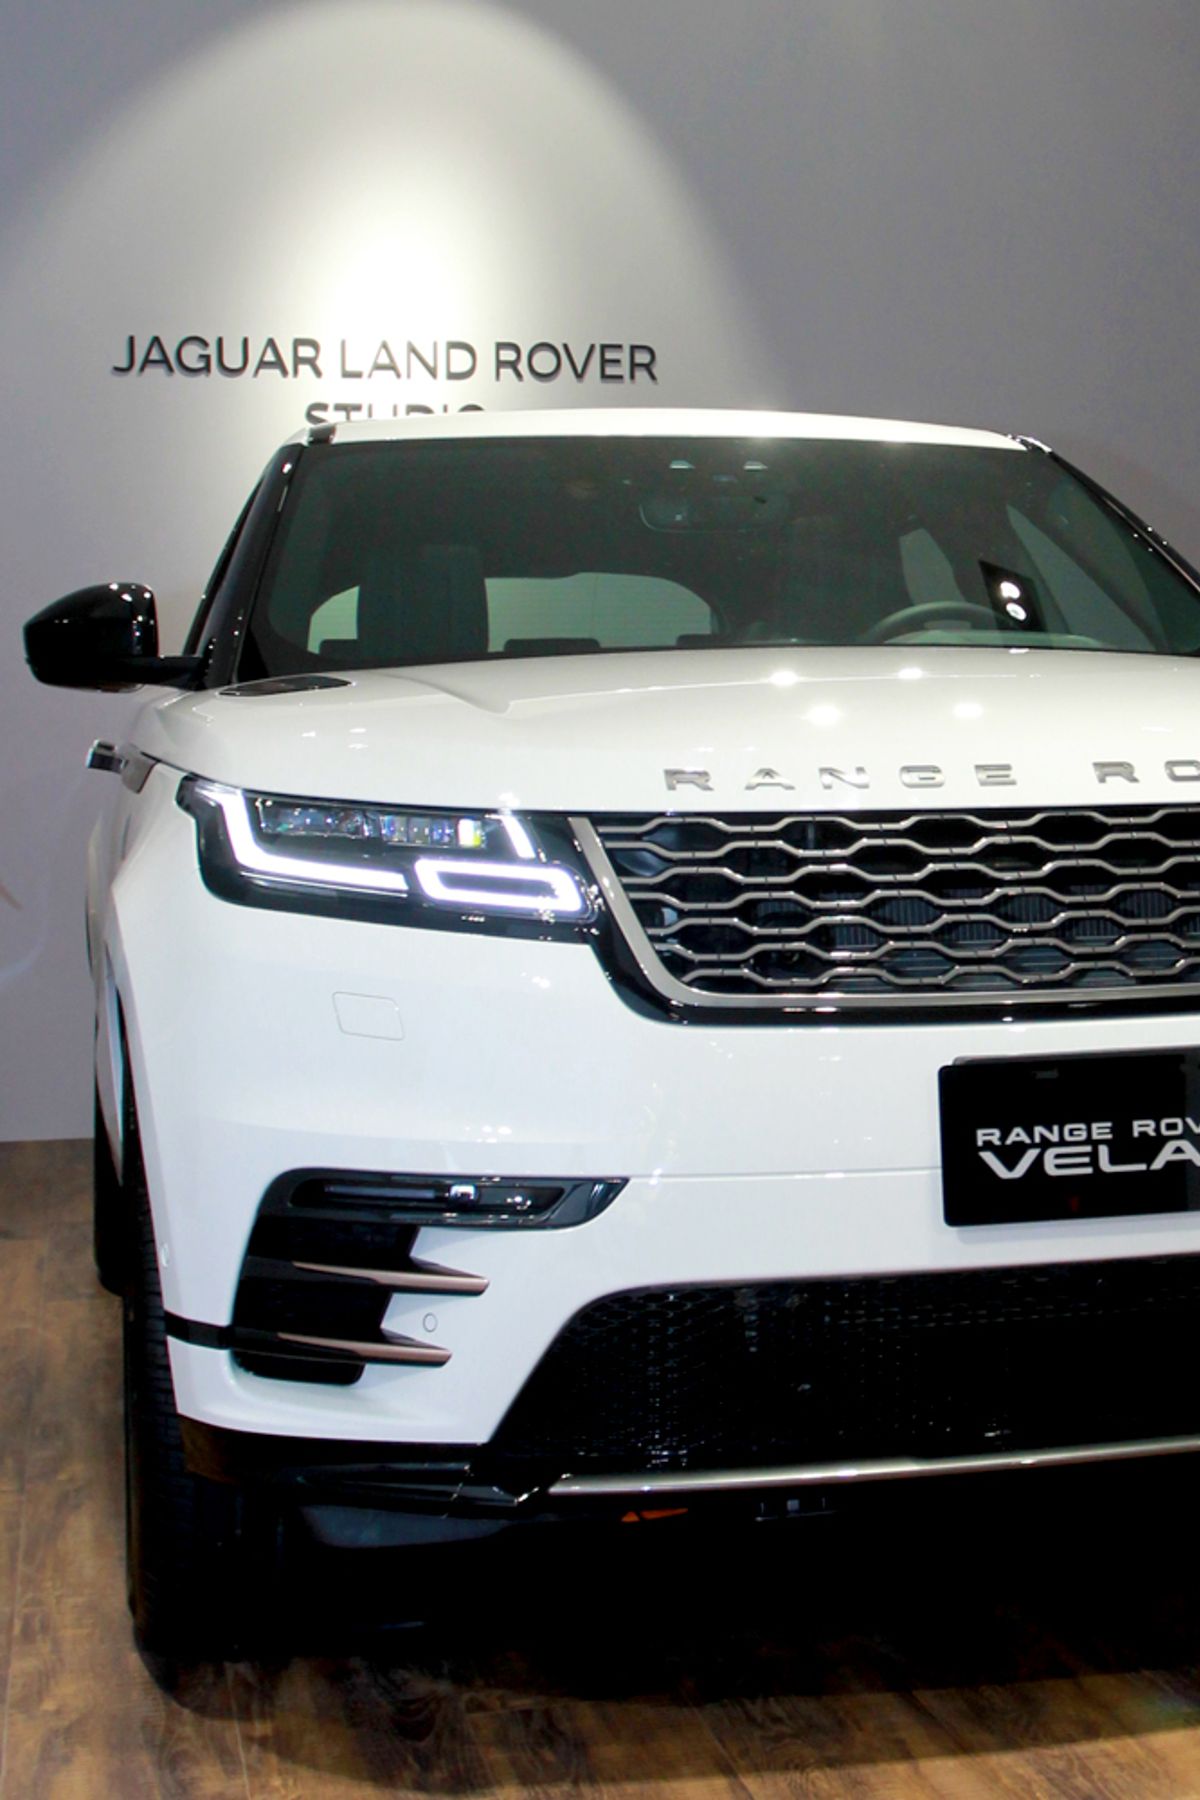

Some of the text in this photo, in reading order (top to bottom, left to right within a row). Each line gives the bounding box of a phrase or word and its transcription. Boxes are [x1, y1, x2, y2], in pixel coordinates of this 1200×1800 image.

[112, 335, 659, 383] JAGUAR LAND ROVER
[664, 764, 1017, 790] RANGE
[976, 1121, 1113, 1147] RANGE
